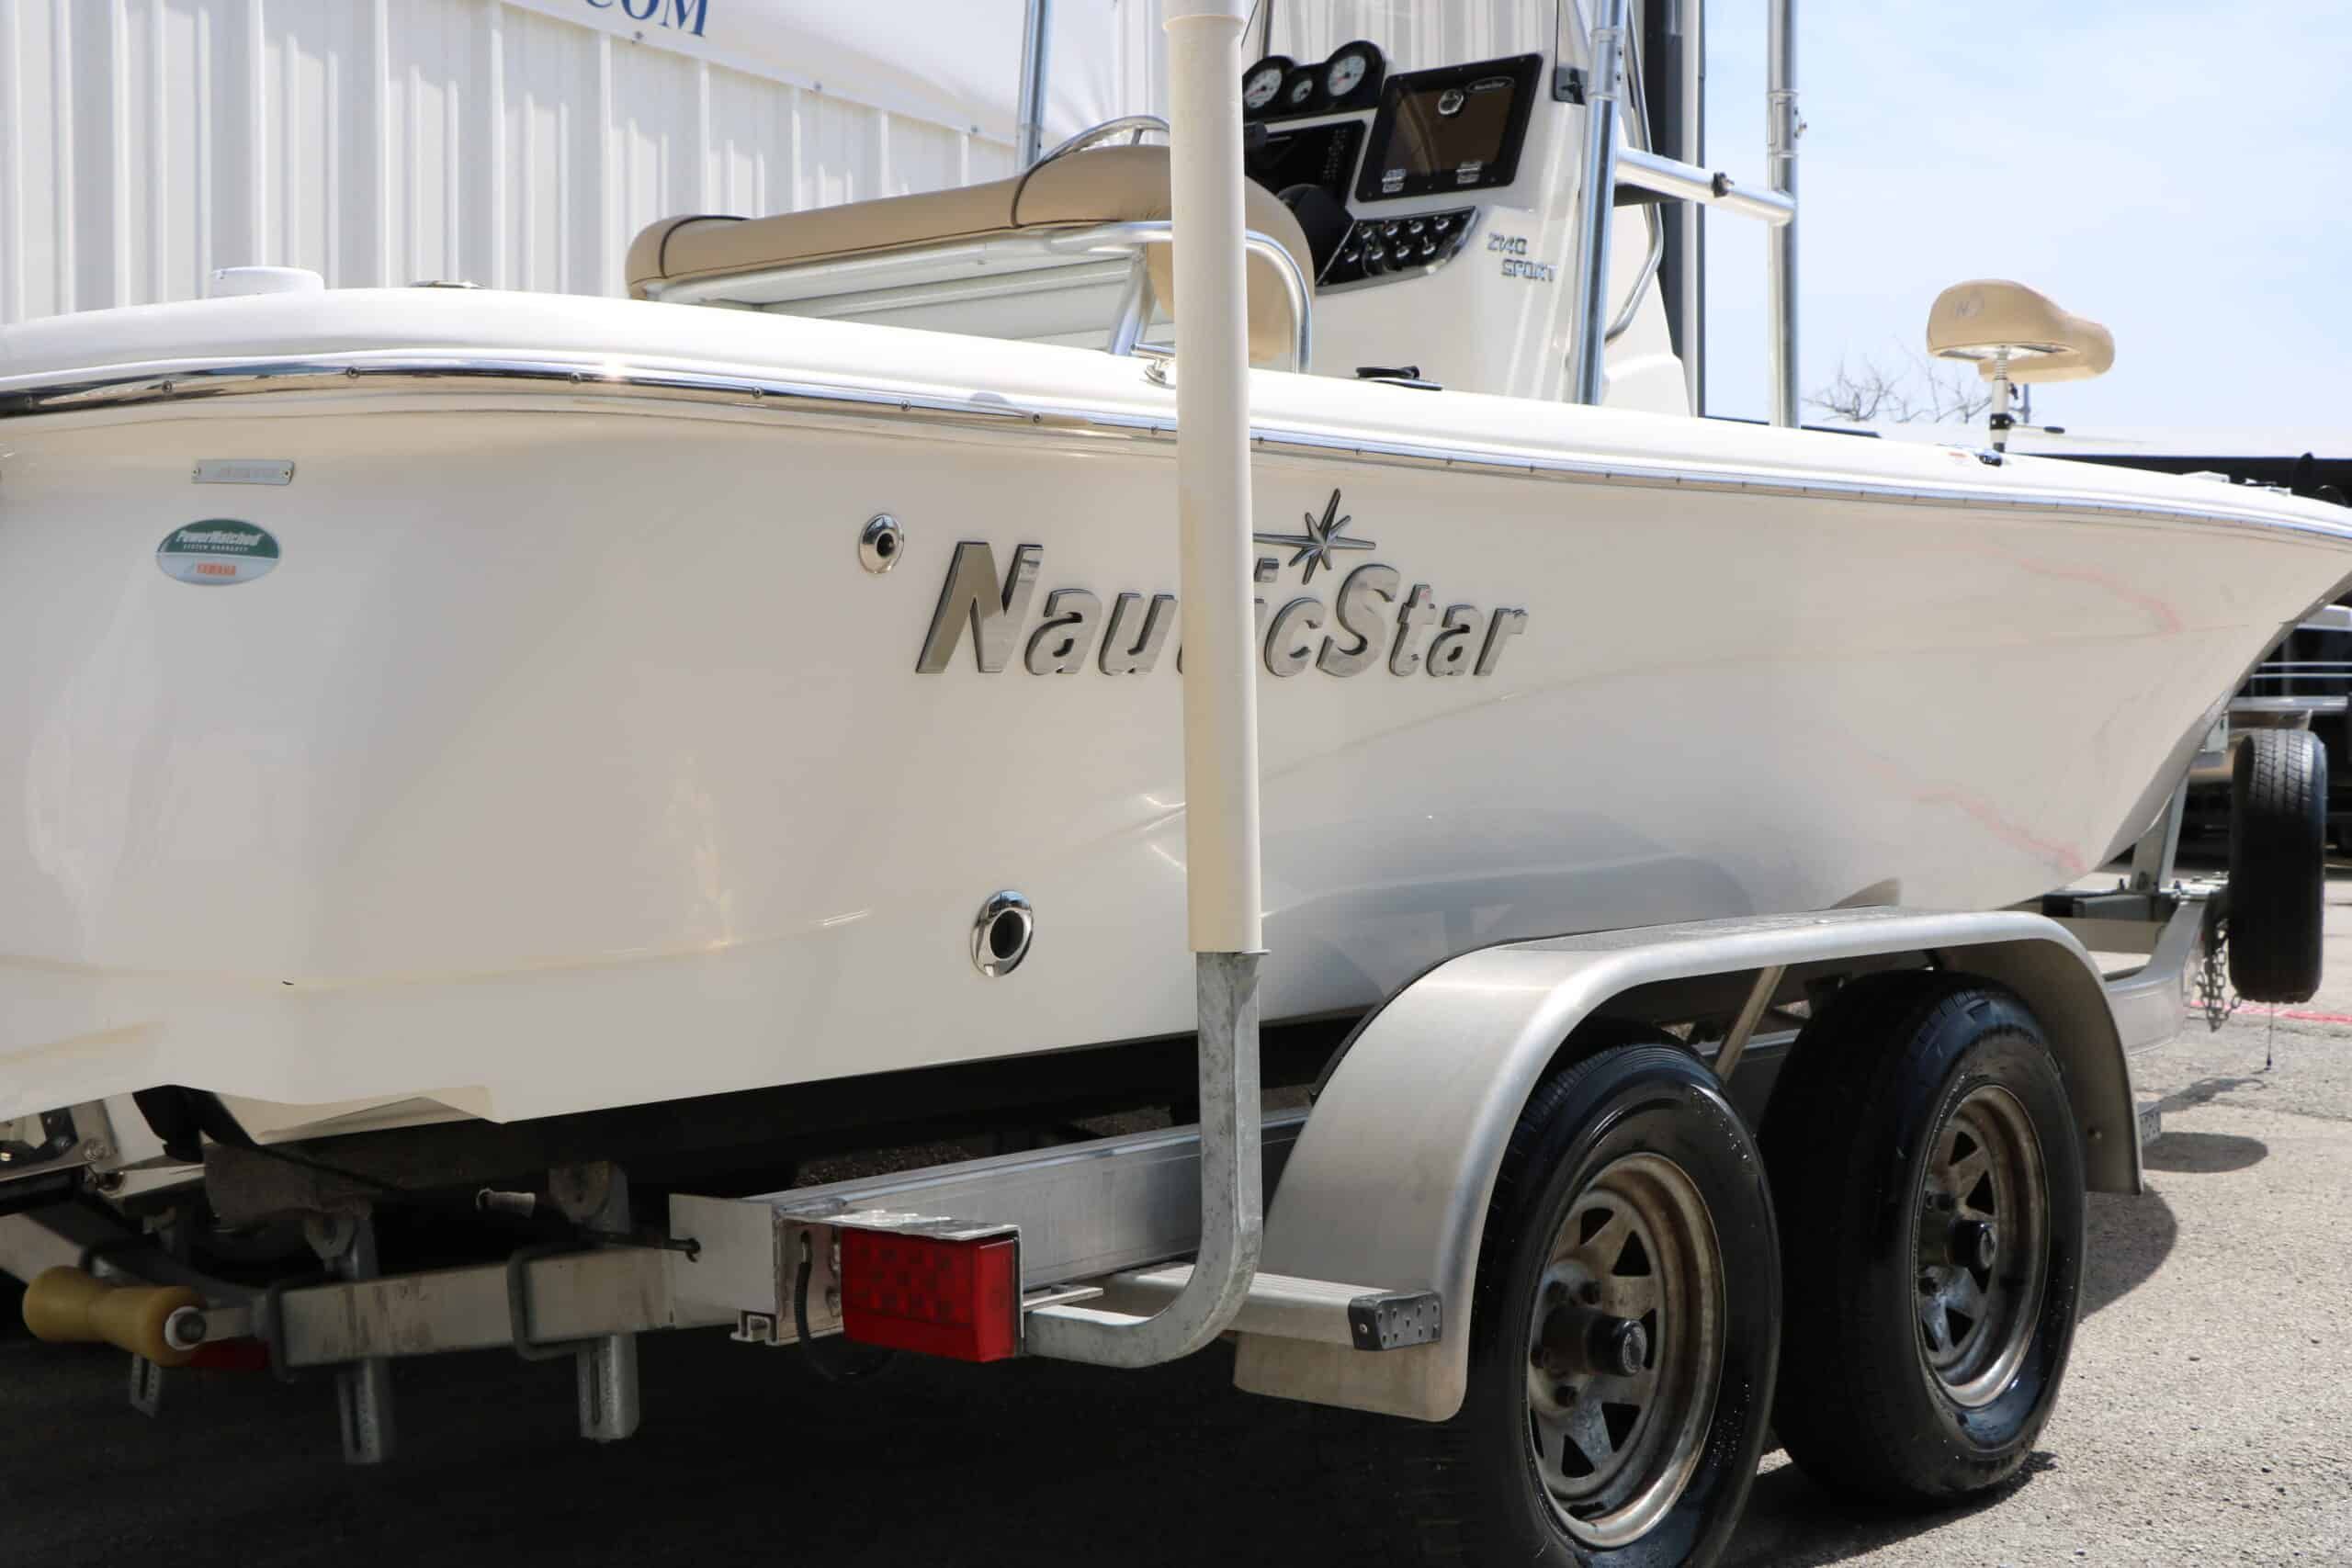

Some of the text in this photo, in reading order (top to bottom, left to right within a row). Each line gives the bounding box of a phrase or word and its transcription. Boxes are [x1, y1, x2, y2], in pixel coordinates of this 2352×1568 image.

[585, 0, 707, 37] OM
[1500, 258, 1557, 282] SPORT
[915, 541, 1528, 677] NaucStar
